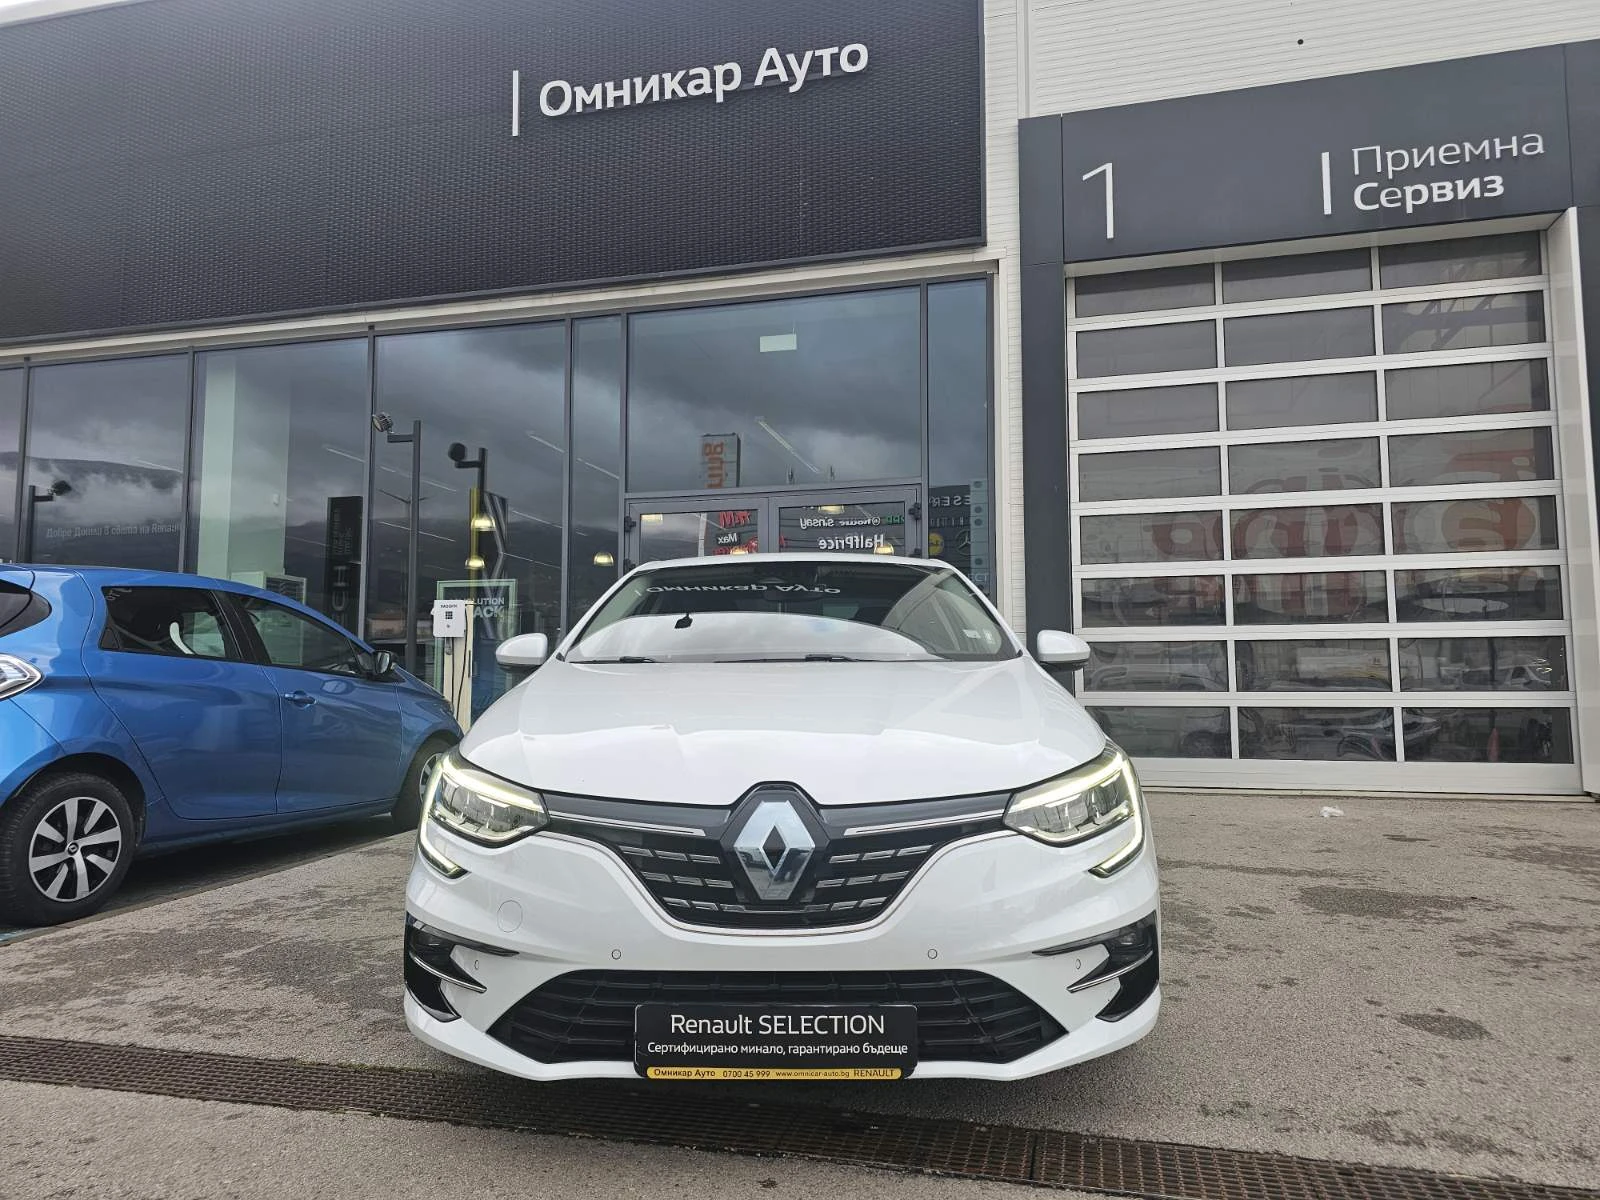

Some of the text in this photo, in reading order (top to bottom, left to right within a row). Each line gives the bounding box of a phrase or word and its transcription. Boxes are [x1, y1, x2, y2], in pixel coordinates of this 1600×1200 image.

[539, 43, 869, 117] Омникар Ауто
[1352, 133, 1545, 180] Приемна
[1082, 162, 1114, 240] 1
[1353, 172, 1504, 213] Сервиз
[670, 1014, 885, 1035] Renault SELECTION
[647, 1042, 908, 1056] Сертифицирано минало, гарантирано бъдеще
[653, 1069, 693, 1078] Омникар
[694, 1069, 716, 1078] Ауто
[722, 1070, 743, 1078] 0700
[744, 1070, 754, 1078] 45
[756, 1070, 771, 1078] 999
[853, 1069, 895, 1078] RENAULT
